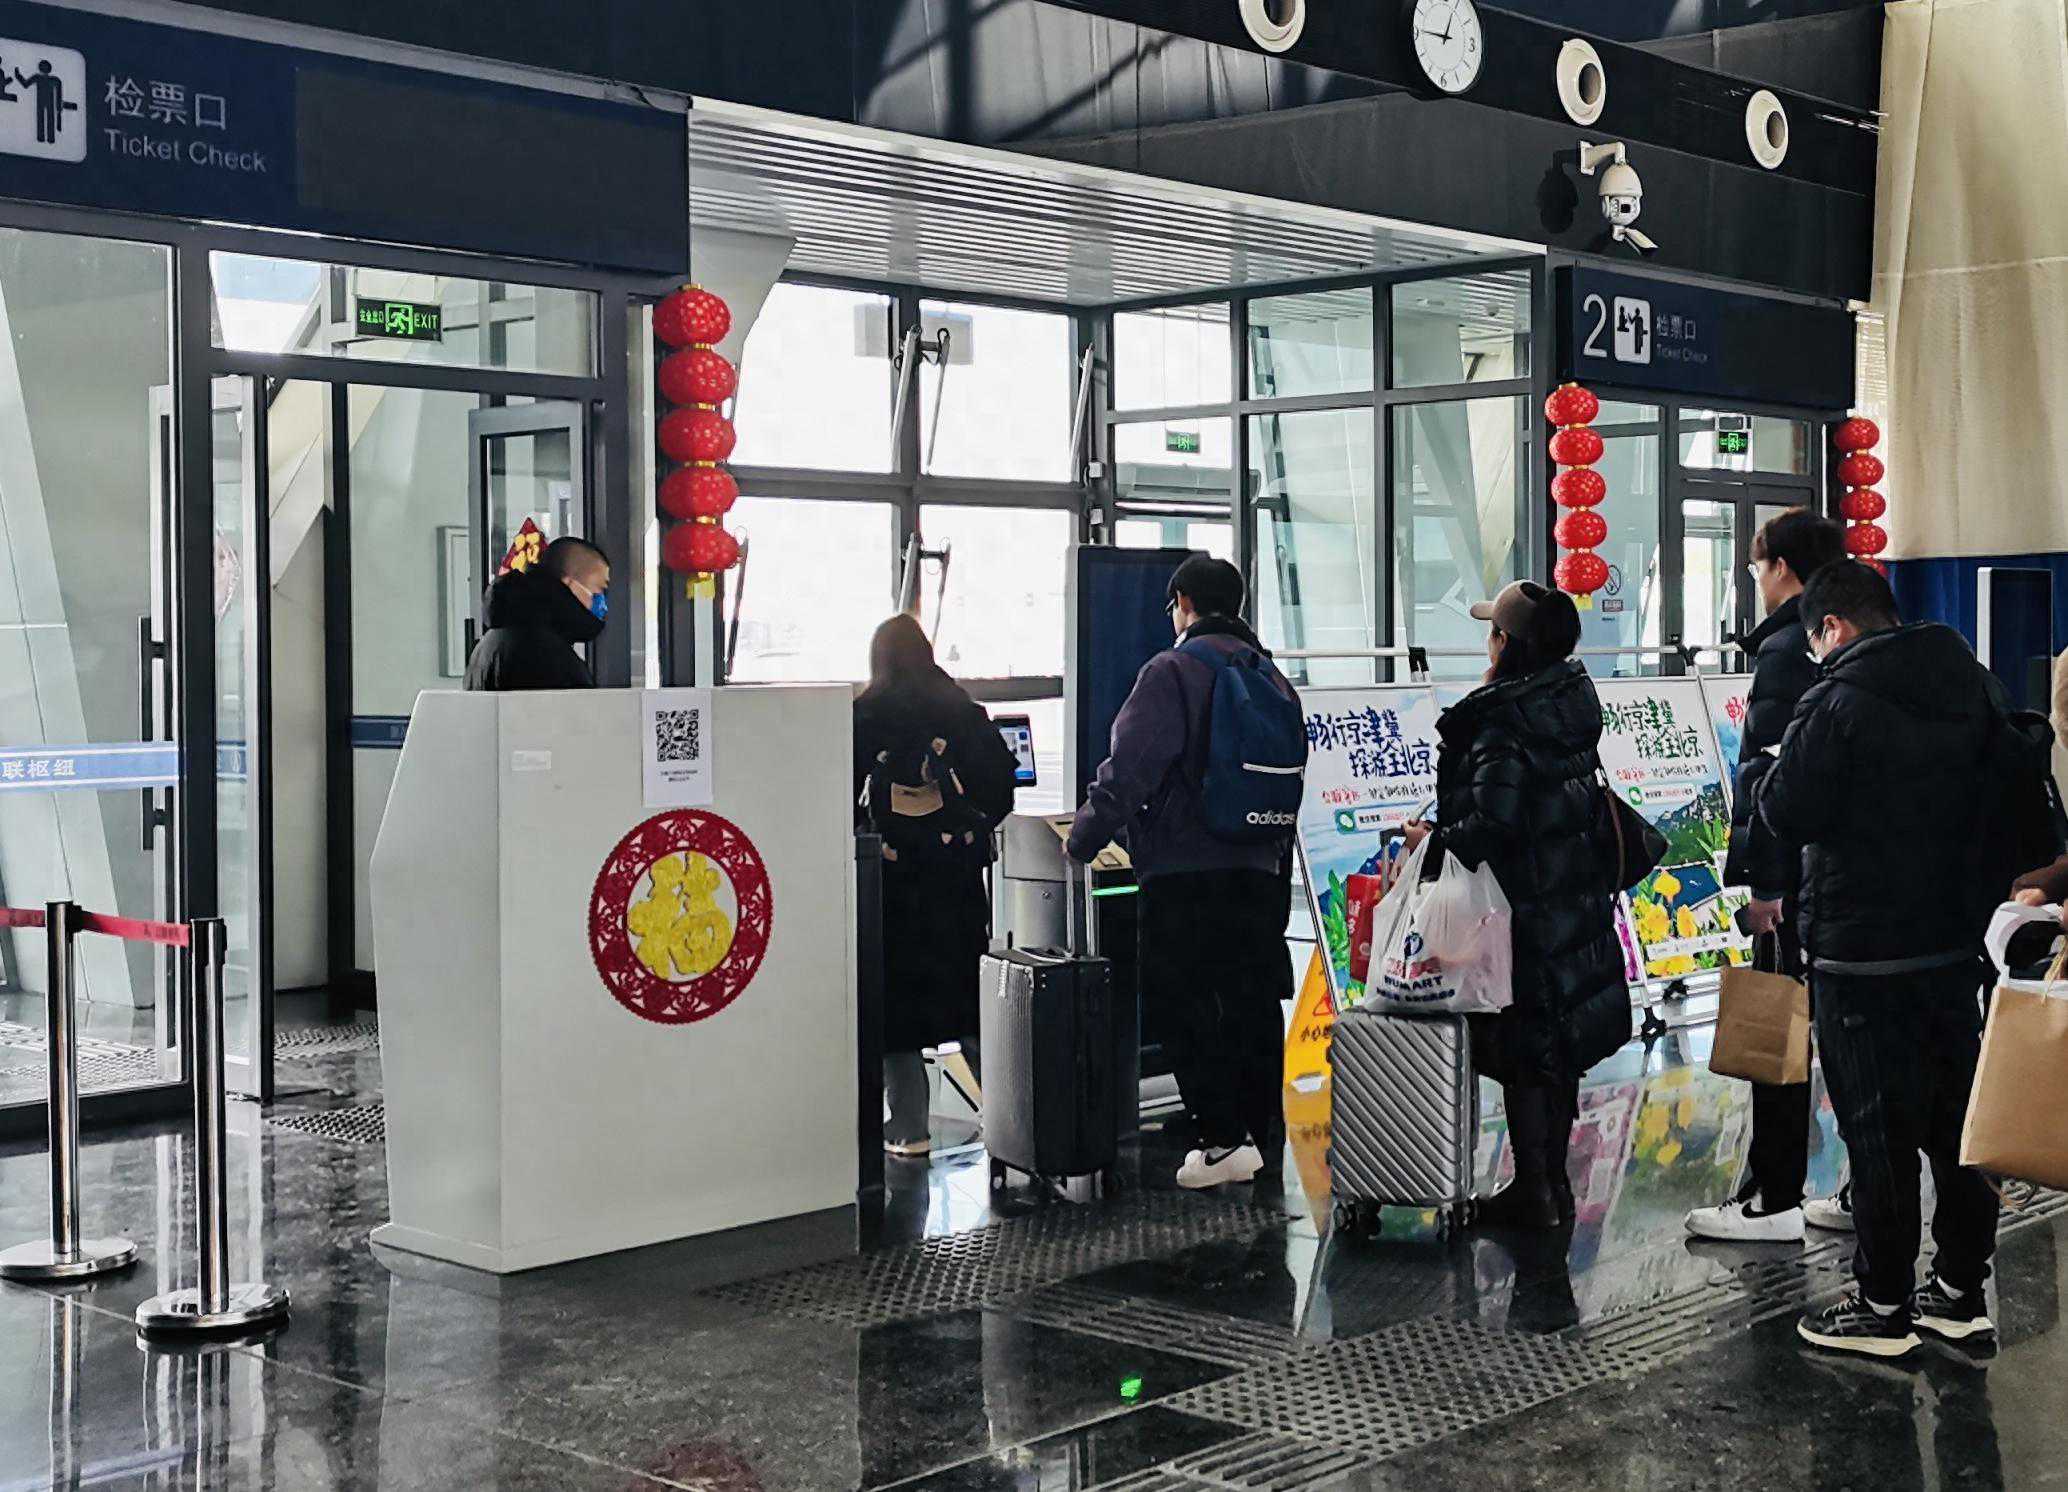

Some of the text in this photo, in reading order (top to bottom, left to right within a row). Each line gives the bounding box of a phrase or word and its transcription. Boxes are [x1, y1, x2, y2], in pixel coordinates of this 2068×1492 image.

[1469, 37, 1475, 52] 3
[1441, 72, 1447, 88] 6
[104, 74, 226, 131] 检票口
[104, 128, 266, 173] Ticket Check
[414, 312, 438, 330] EXIT
[1583, 293, 1607, 357] 2
[1304, 705, 1403, 752] 畅行京津冀
[1601, 695, 1676, 736] 畅行京津冀
[1724, 696, 1746, 728] 畅
[1, 758, 76, 779] 联枢纽
[1348, 737, 1437, 780] 探游全北京
[1246, 810, 1296, 825] adidas
